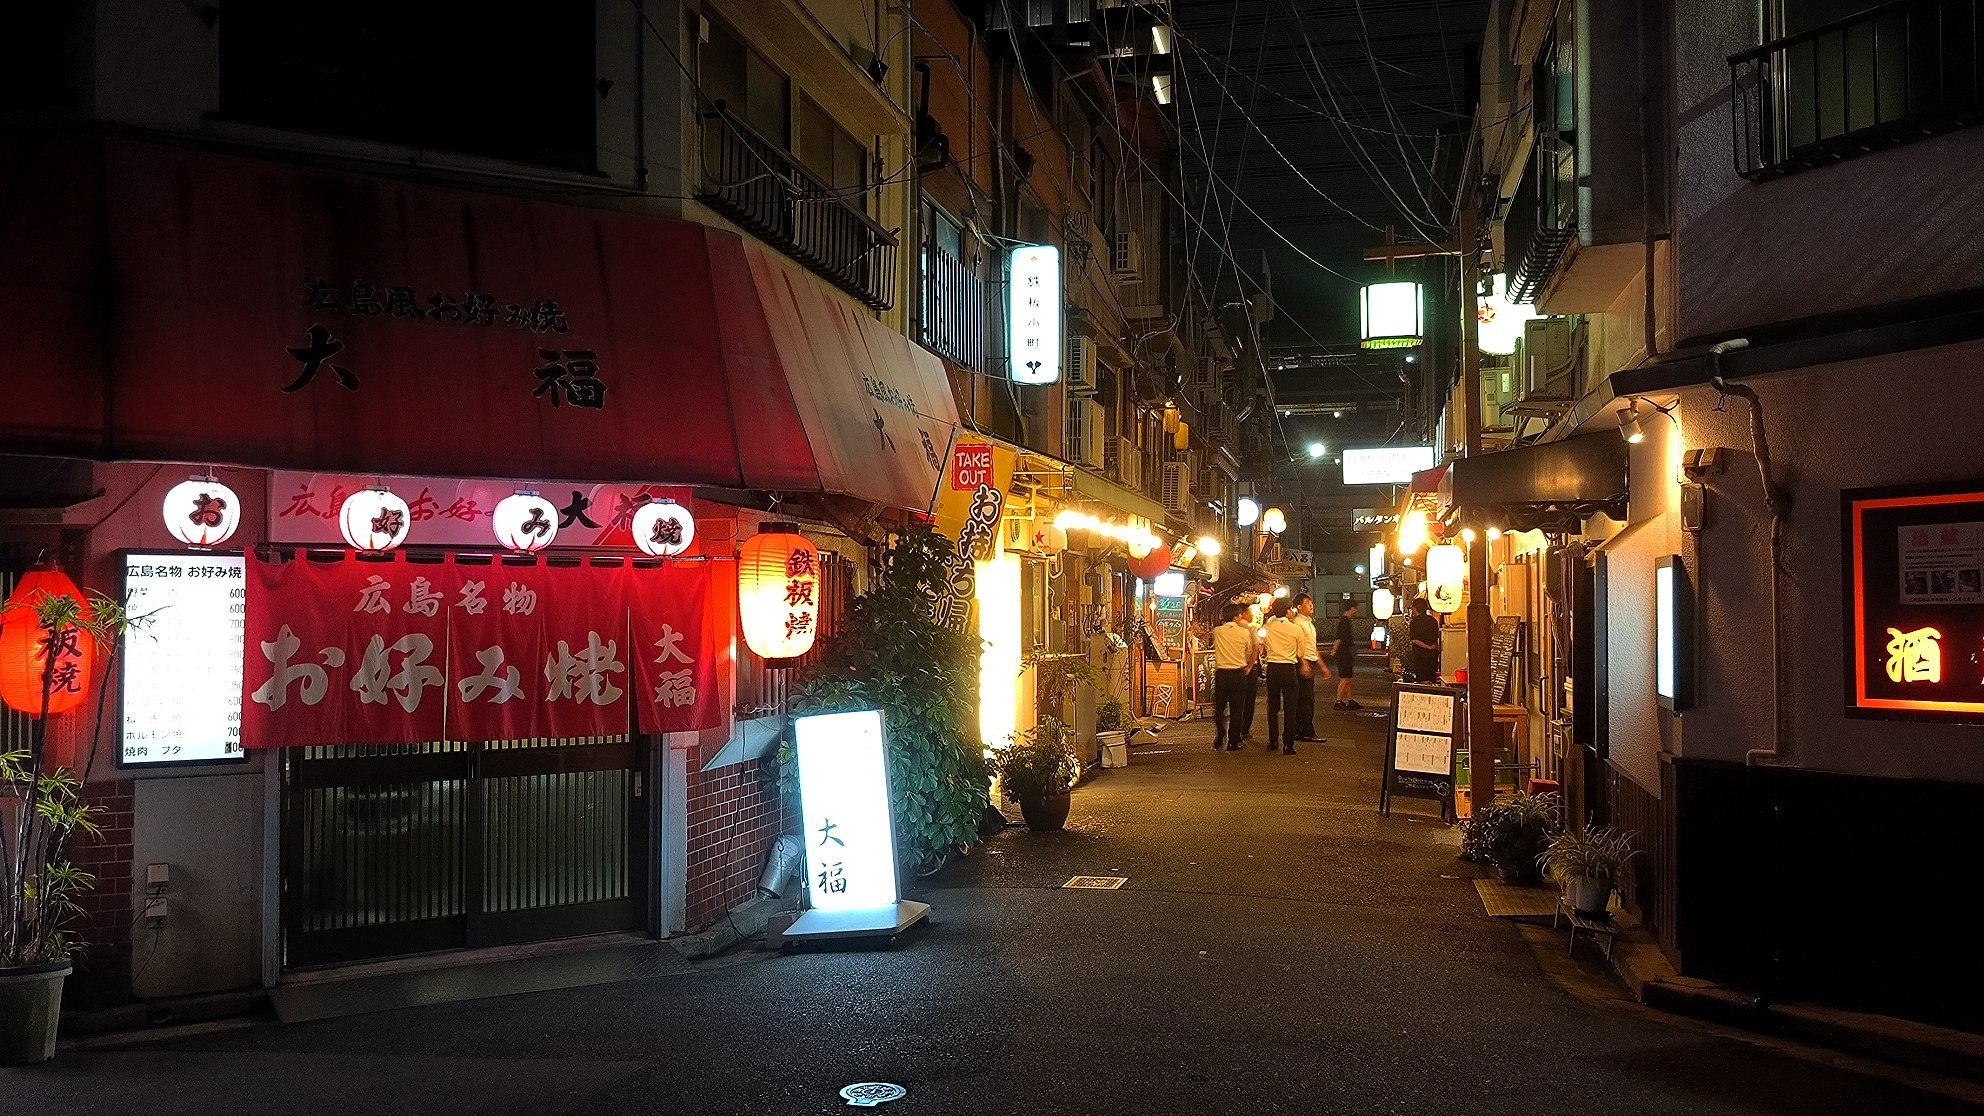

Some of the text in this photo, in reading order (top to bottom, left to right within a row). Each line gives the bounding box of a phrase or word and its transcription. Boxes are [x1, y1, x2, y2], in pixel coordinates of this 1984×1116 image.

[955, 452, 991, 468] TAKE
[958, 470, 987, 485] OUT
[189, 494, 227, 528] お
[371, 507, 405, 537] 好
[520, 508, 552, 537] み
[650, 517, 684, 546] 焼
[127, 565, 242, 579] 広島名物 お好み焼
[229, 588, 246, 598] 600
[353, 574, 537, 618] 広島名物
[784, 548, 815, 640] 鉄板焼
[251, 624, 625, 713] お好み焼
[653, 623, 697, 708] 大福
[125, 747, 148, 757] 焼肉
[818, 817, 847, 894] 大福
